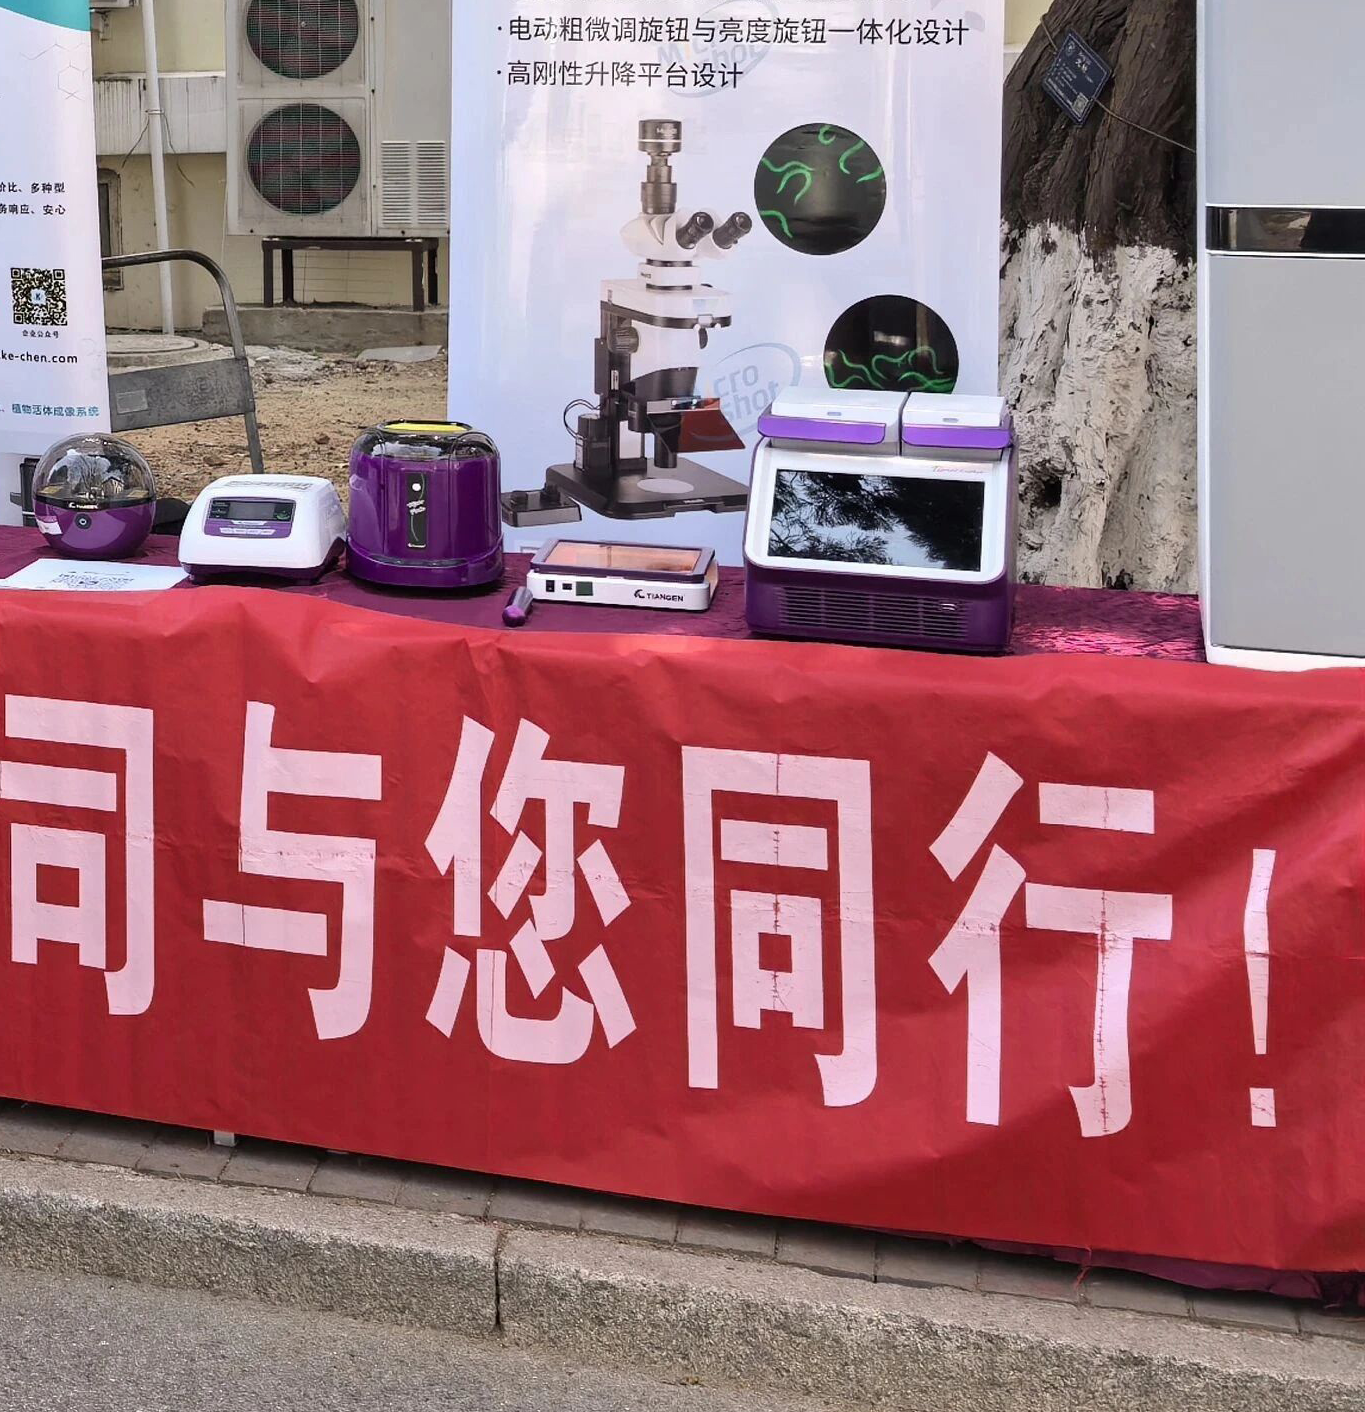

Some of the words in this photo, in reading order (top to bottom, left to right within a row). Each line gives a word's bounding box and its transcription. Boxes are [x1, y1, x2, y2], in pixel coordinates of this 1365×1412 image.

[508, 15, 970, 46] 电动粗微调旋钮与亮度旋钮一体化设计
[507, 59, 745, 90] 高刚性升降平台设计
[646, 592, 684, 602] TIANGEN
